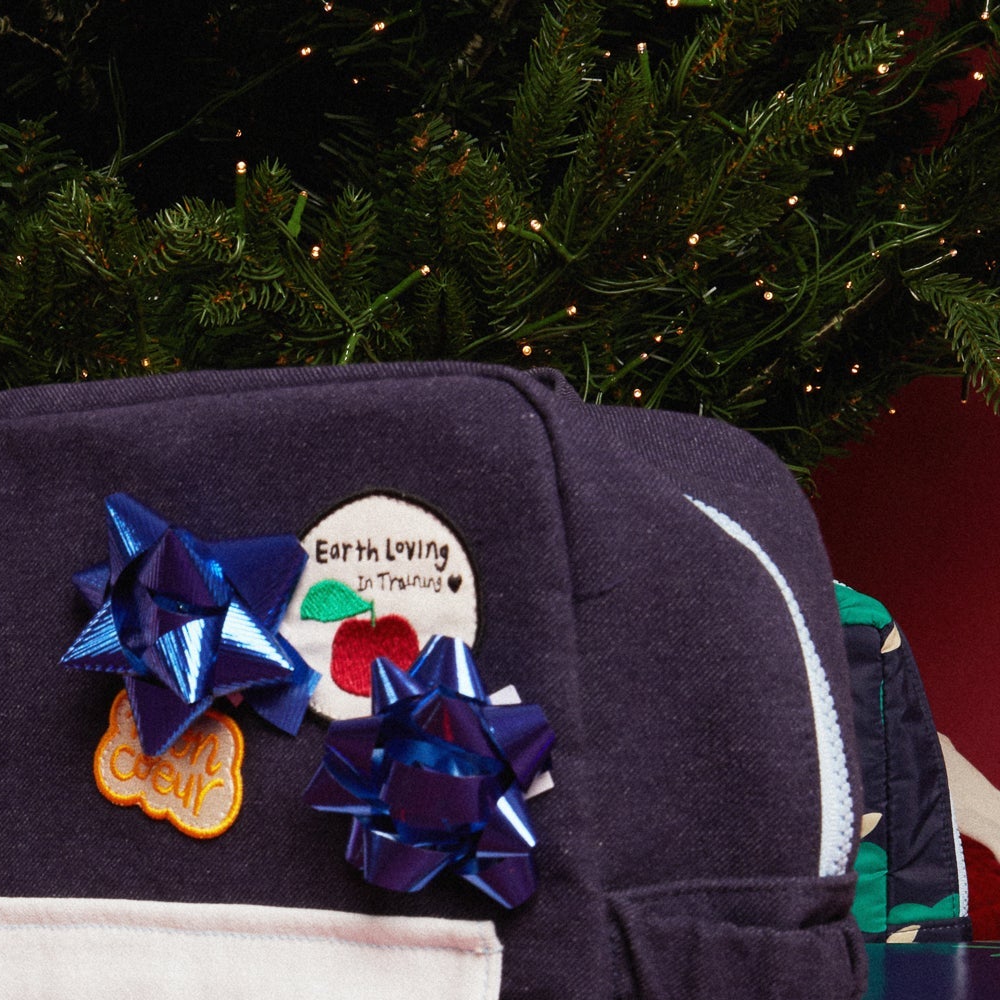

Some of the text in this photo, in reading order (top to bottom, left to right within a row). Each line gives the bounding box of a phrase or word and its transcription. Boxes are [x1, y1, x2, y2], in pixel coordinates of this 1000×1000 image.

[315, 538, 449, 572] Earth Loving
[357, 572, 442, 593] In Training
